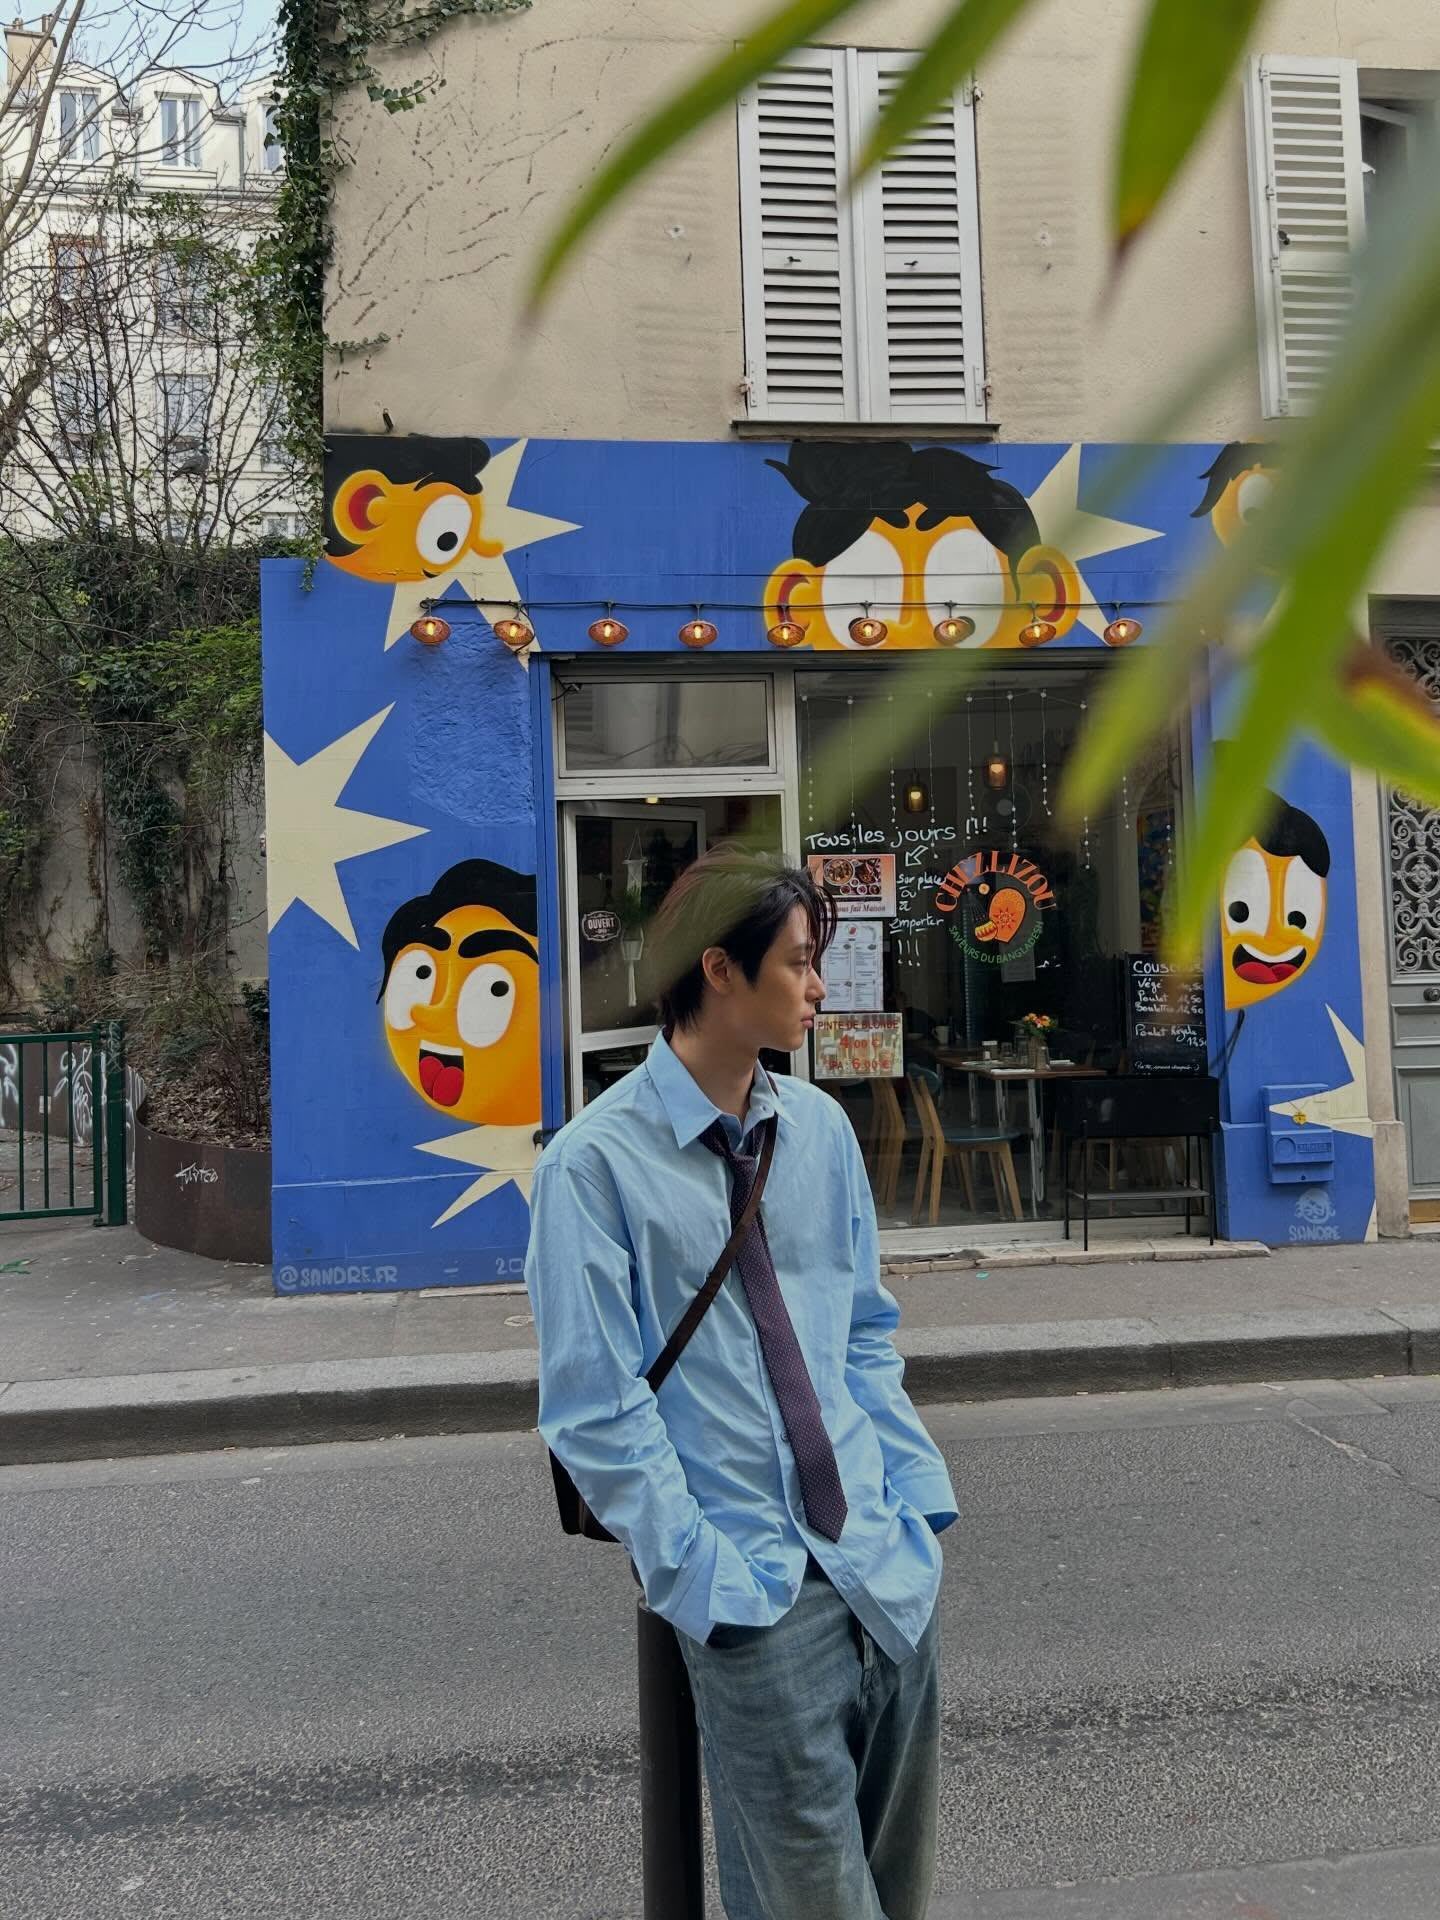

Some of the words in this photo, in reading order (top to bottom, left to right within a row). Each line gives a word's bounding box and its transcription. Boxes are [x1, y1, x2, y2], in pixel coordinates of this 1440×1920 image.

[857, 824, 885, 844] les
[890, 826, 957, 848] jours
[990, 850, 1057, 911] LIZOU
[588, 918, 615, 930] OUVERT
[949, 925, 980, 960] SAVEURS
[980, 956, 995, 964] DU
[996, 920, 1045, 964] BANGLADESH
[1137, 990, 1168, 1002] Poulet
[817, 1021, 844, 1030] PINTE
[847, 1021, 859, 1030] DE
[861, 1020, 899, 1030] BLONDE
[1289, 1225, 1341, 1241] SANDRE
